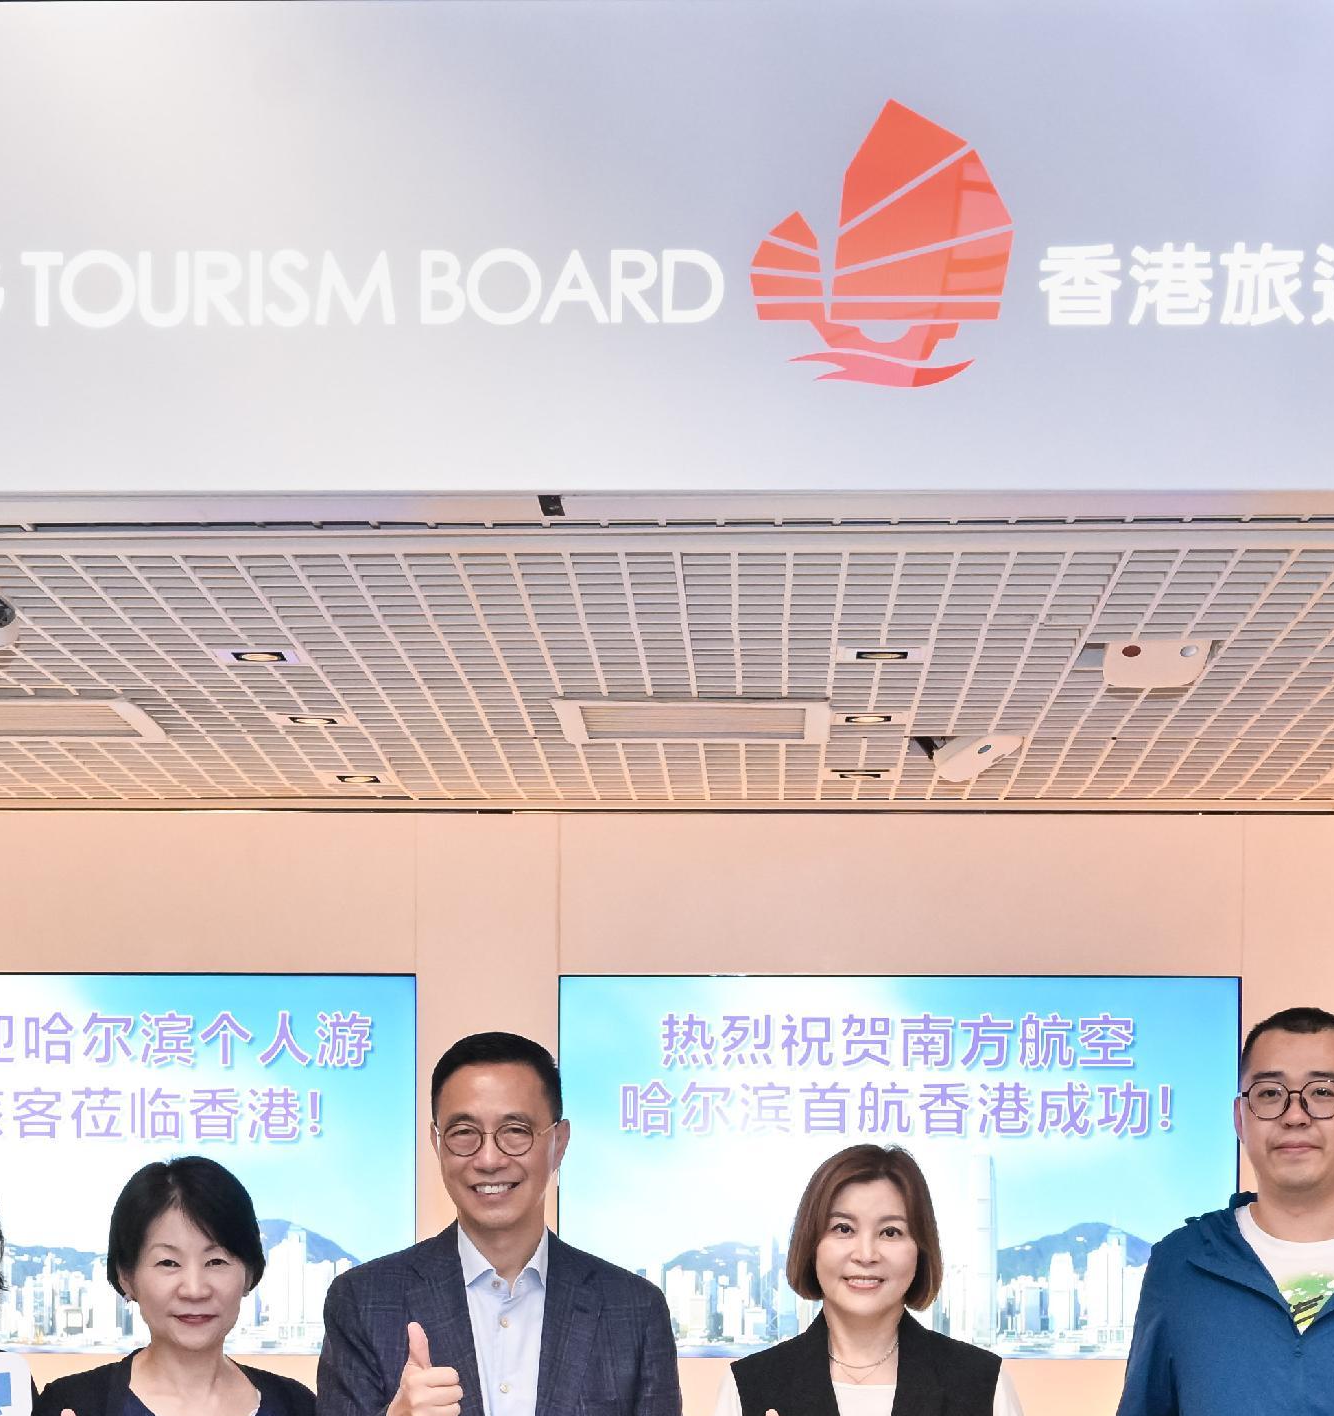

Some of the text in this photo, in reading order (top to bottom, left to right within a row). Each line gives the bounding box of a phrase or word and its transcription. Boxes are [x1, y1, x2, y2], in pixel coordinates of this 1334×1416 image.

[21, 248, 395, 328] TOURISM
[419, 248, 725, 325] BOARD
[661, 1013, 1135, 1068] 热烈祝贺南方航空
